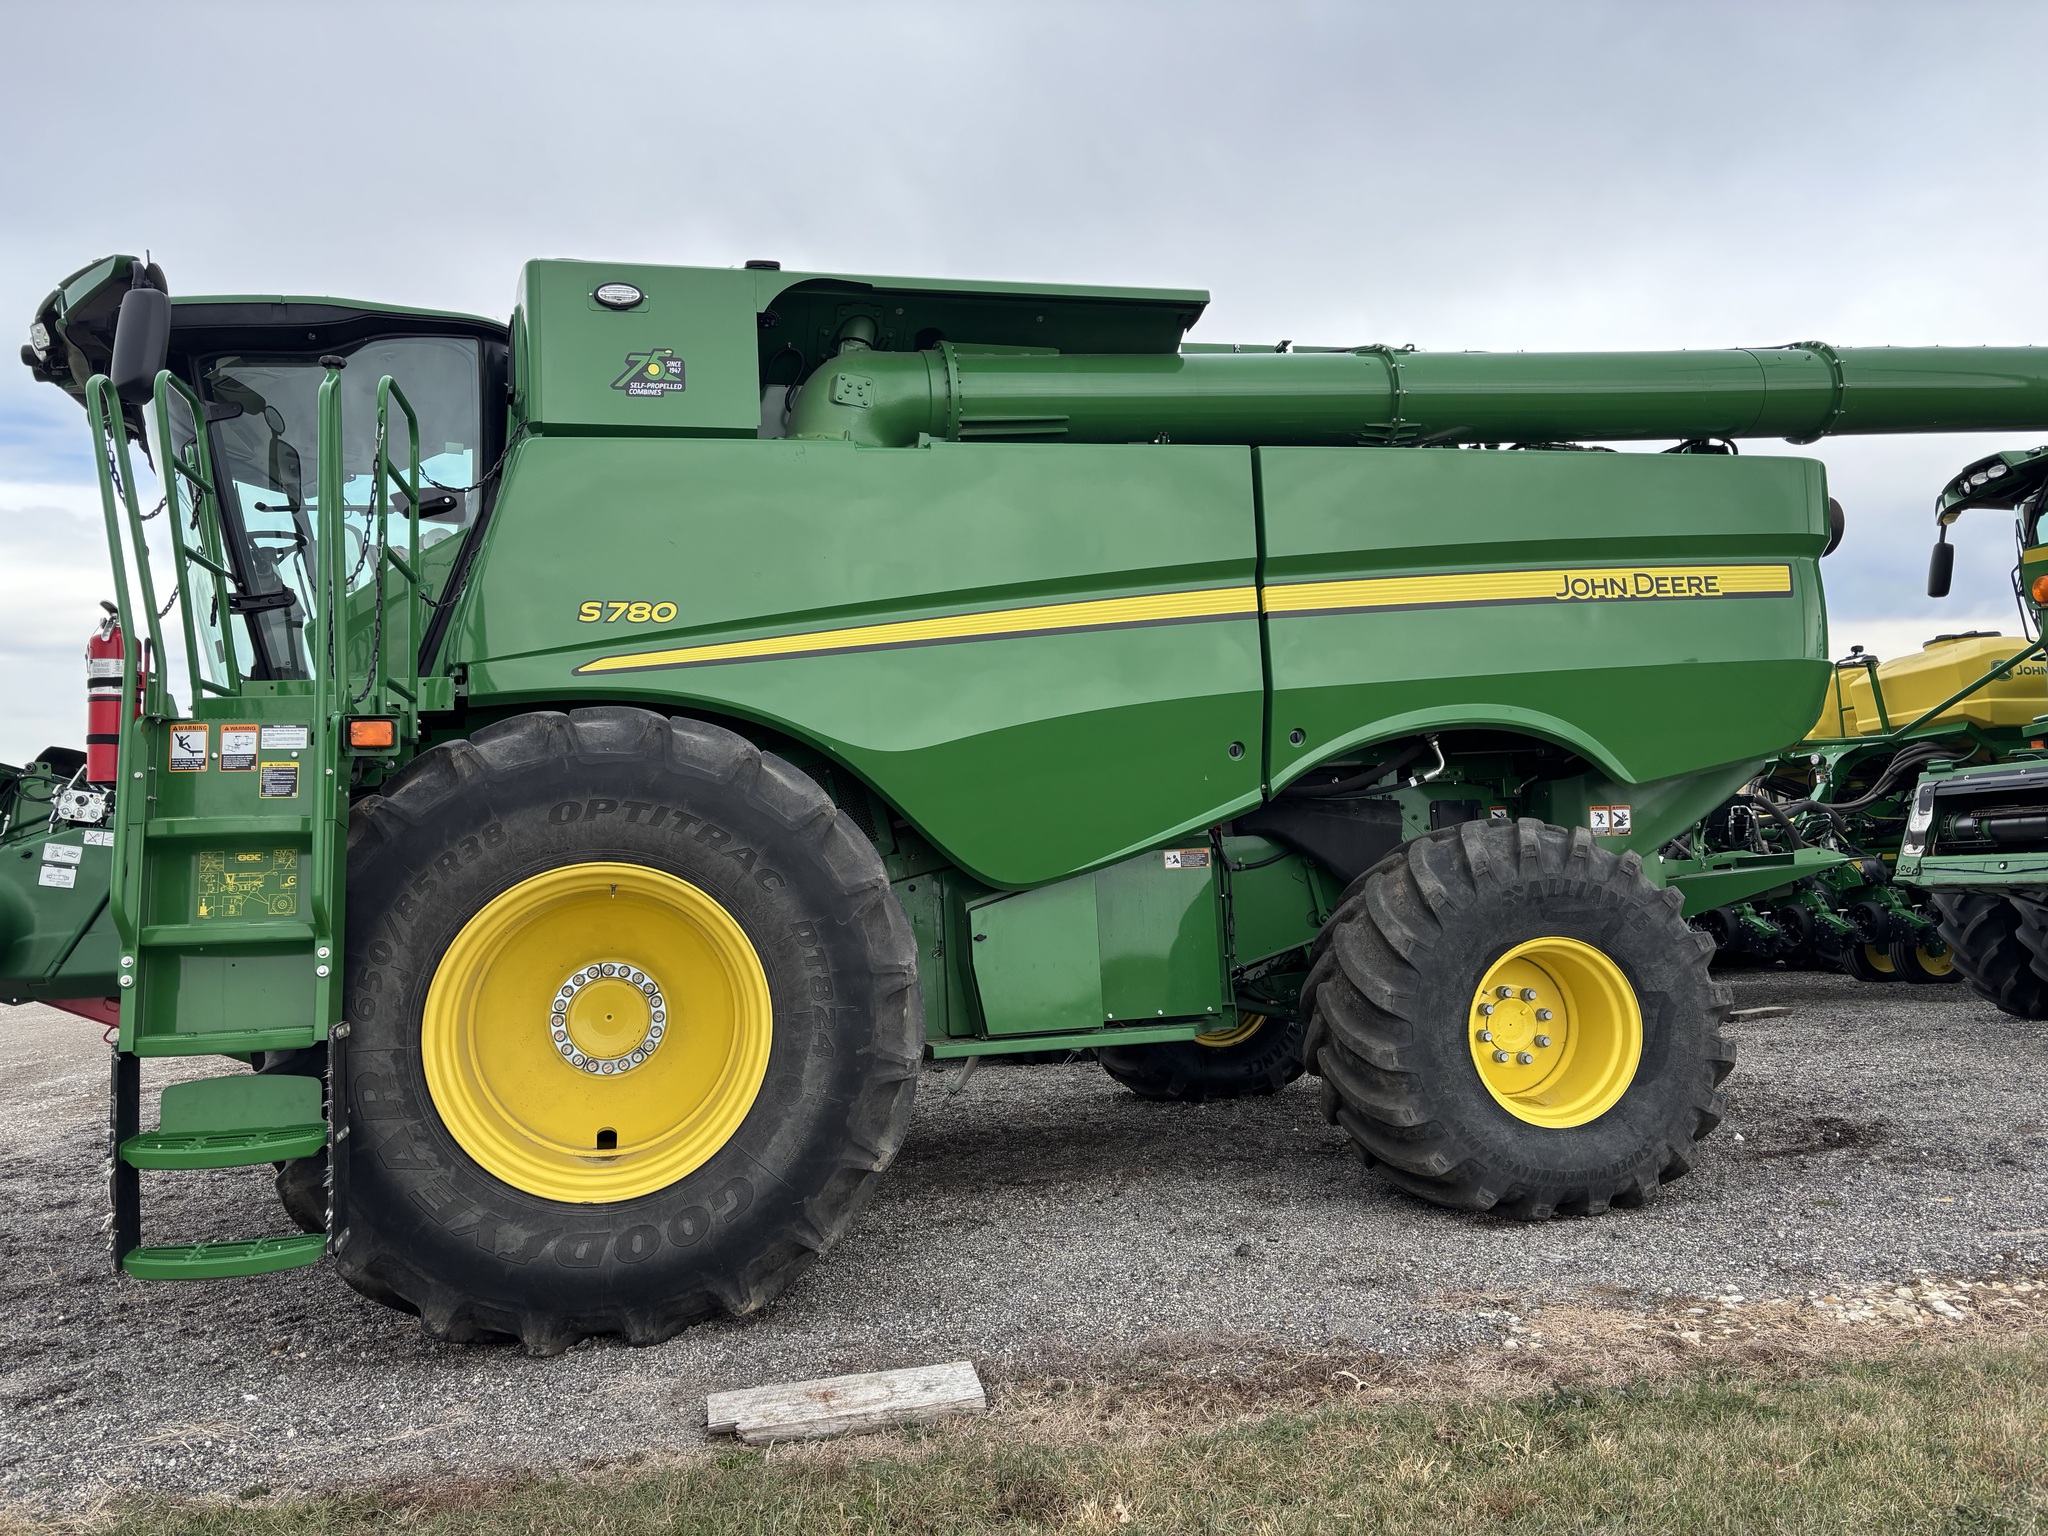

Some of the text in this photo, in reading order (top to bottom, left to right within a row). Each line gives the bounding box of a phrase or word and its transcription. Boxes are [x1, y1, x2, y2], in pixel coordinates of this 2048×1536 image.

[666, 360, 681, 368] SINCE
[628, 388, 662, 396] COMBINES
[629, 381, 683, 390] SELF-PROPELLED
[1556, 573, 1720, 597] JOHN DEERE
[577, 600, 679, 623] S780
[549, 799, 786, 894] OPTITRAC
[351, 821, 508, 1022] 650/85R38
[1527, 878, 1652, 933] ALLIANCE
[788, 920, 837, 1059] DT824
[354, 1071, 755, 1269] GOODYEAR
[1611, 1142, 1653, 1177] SUPER
